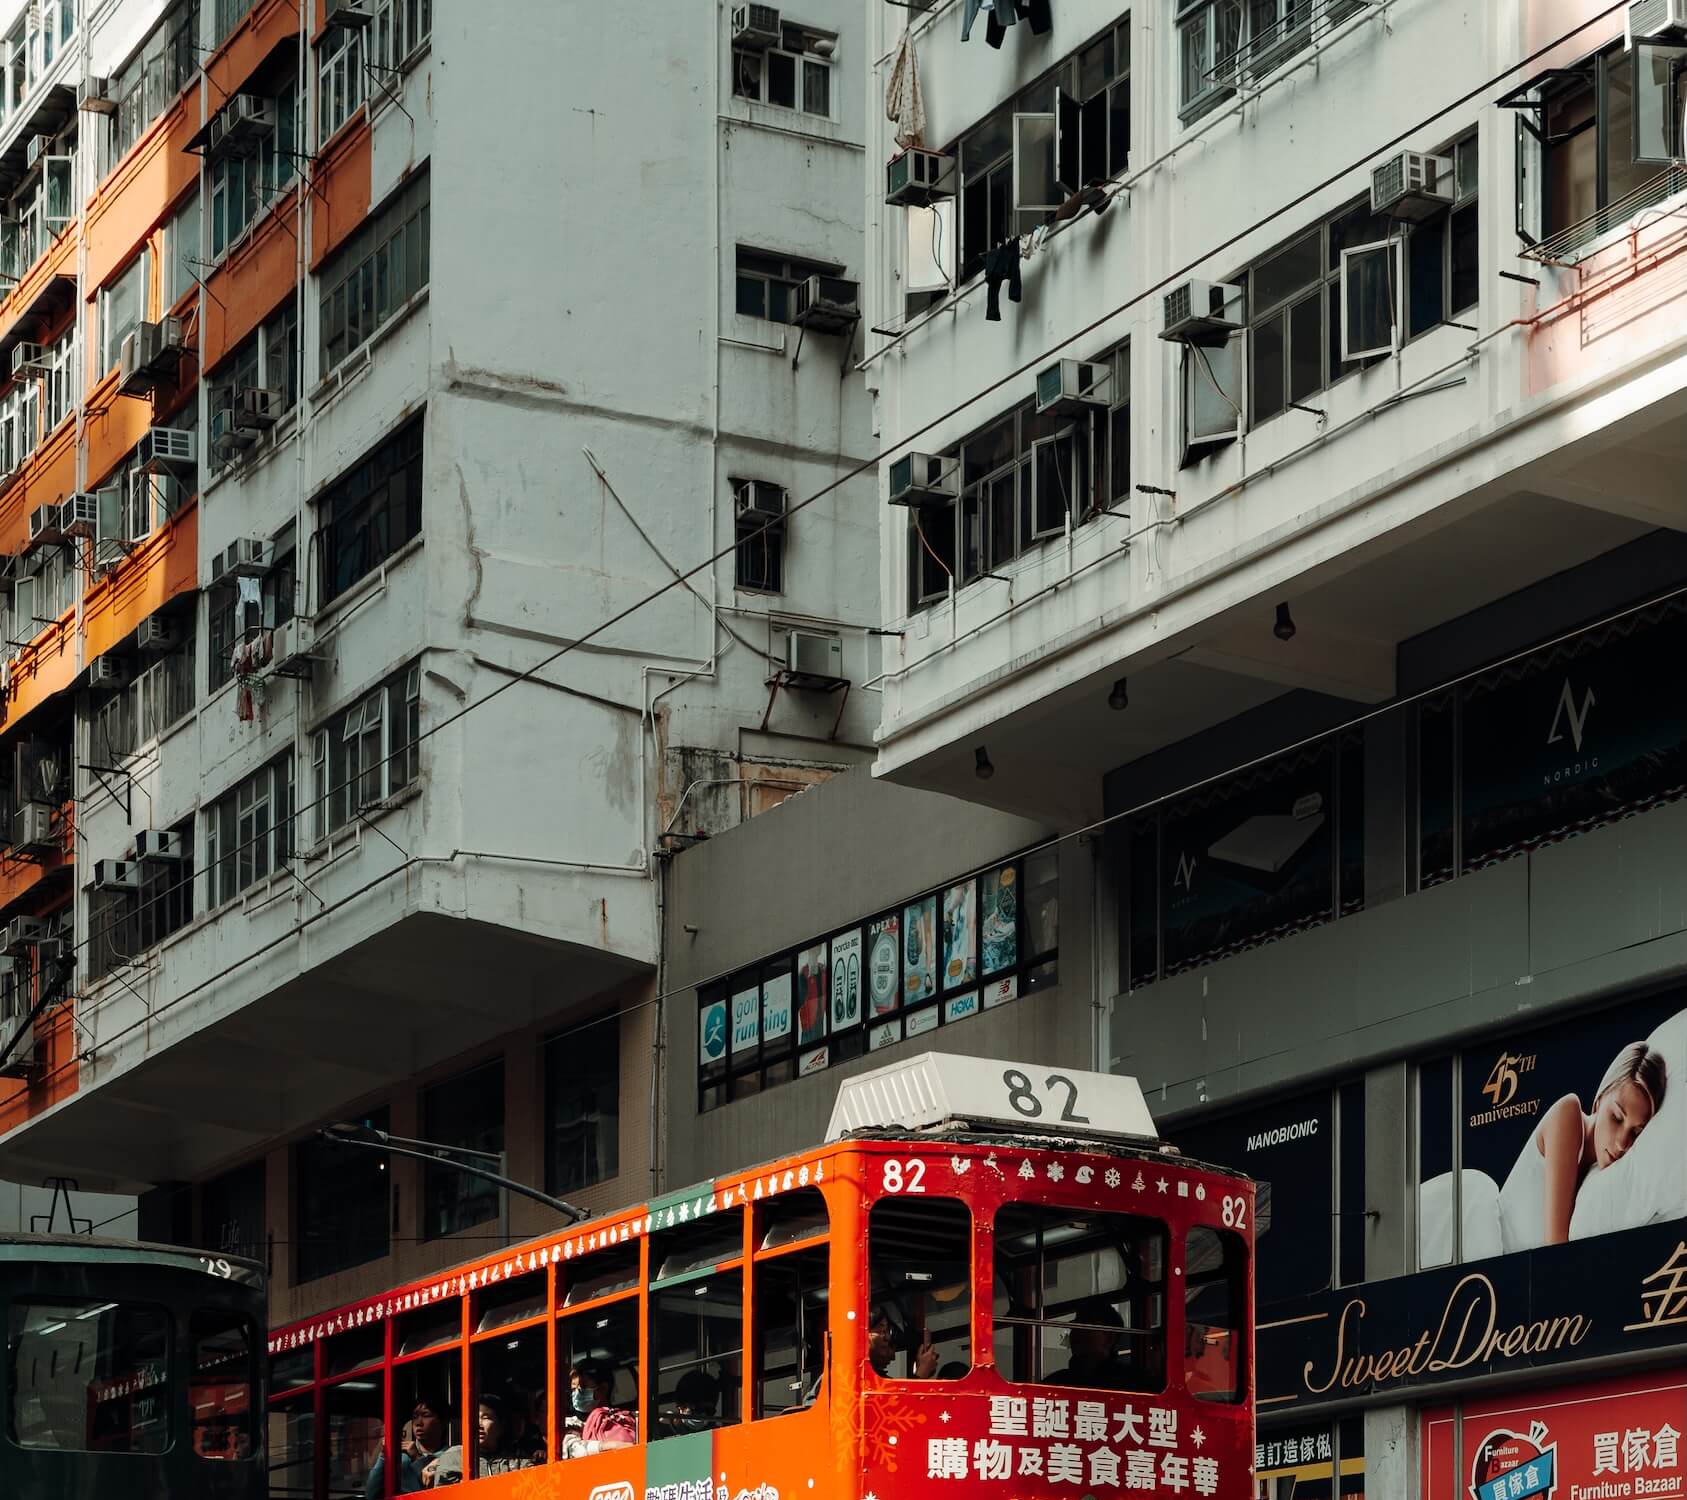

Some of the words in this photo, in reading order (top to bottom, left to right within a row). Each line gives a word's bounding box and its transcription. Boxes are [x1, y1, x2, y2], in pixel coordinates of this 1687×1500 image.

[1544, 757, 1600, 785] NORDIC
[1003, 1068, 1091, 1124] 82
[1469, 1098, 1541, 1128] anniversary
[1247, 1117, 1319, 1153] NANOBIONIC
[882, 1159, 926, 1194] 82
[1221, 1195, 1247, 1230] 82
[201, 1257, 233, 1280] 29
[988, 1395, 1179, 1449] 聖誕最大型
[1484, 1444, 1519, 1463] Furniture
[1592, 1422, 1682, 1477] 買傢倉
[926, 1438, 1220, 1497] 購物及美食嘉年華
[1634, 1475, 1683, 1496] Bazaar
